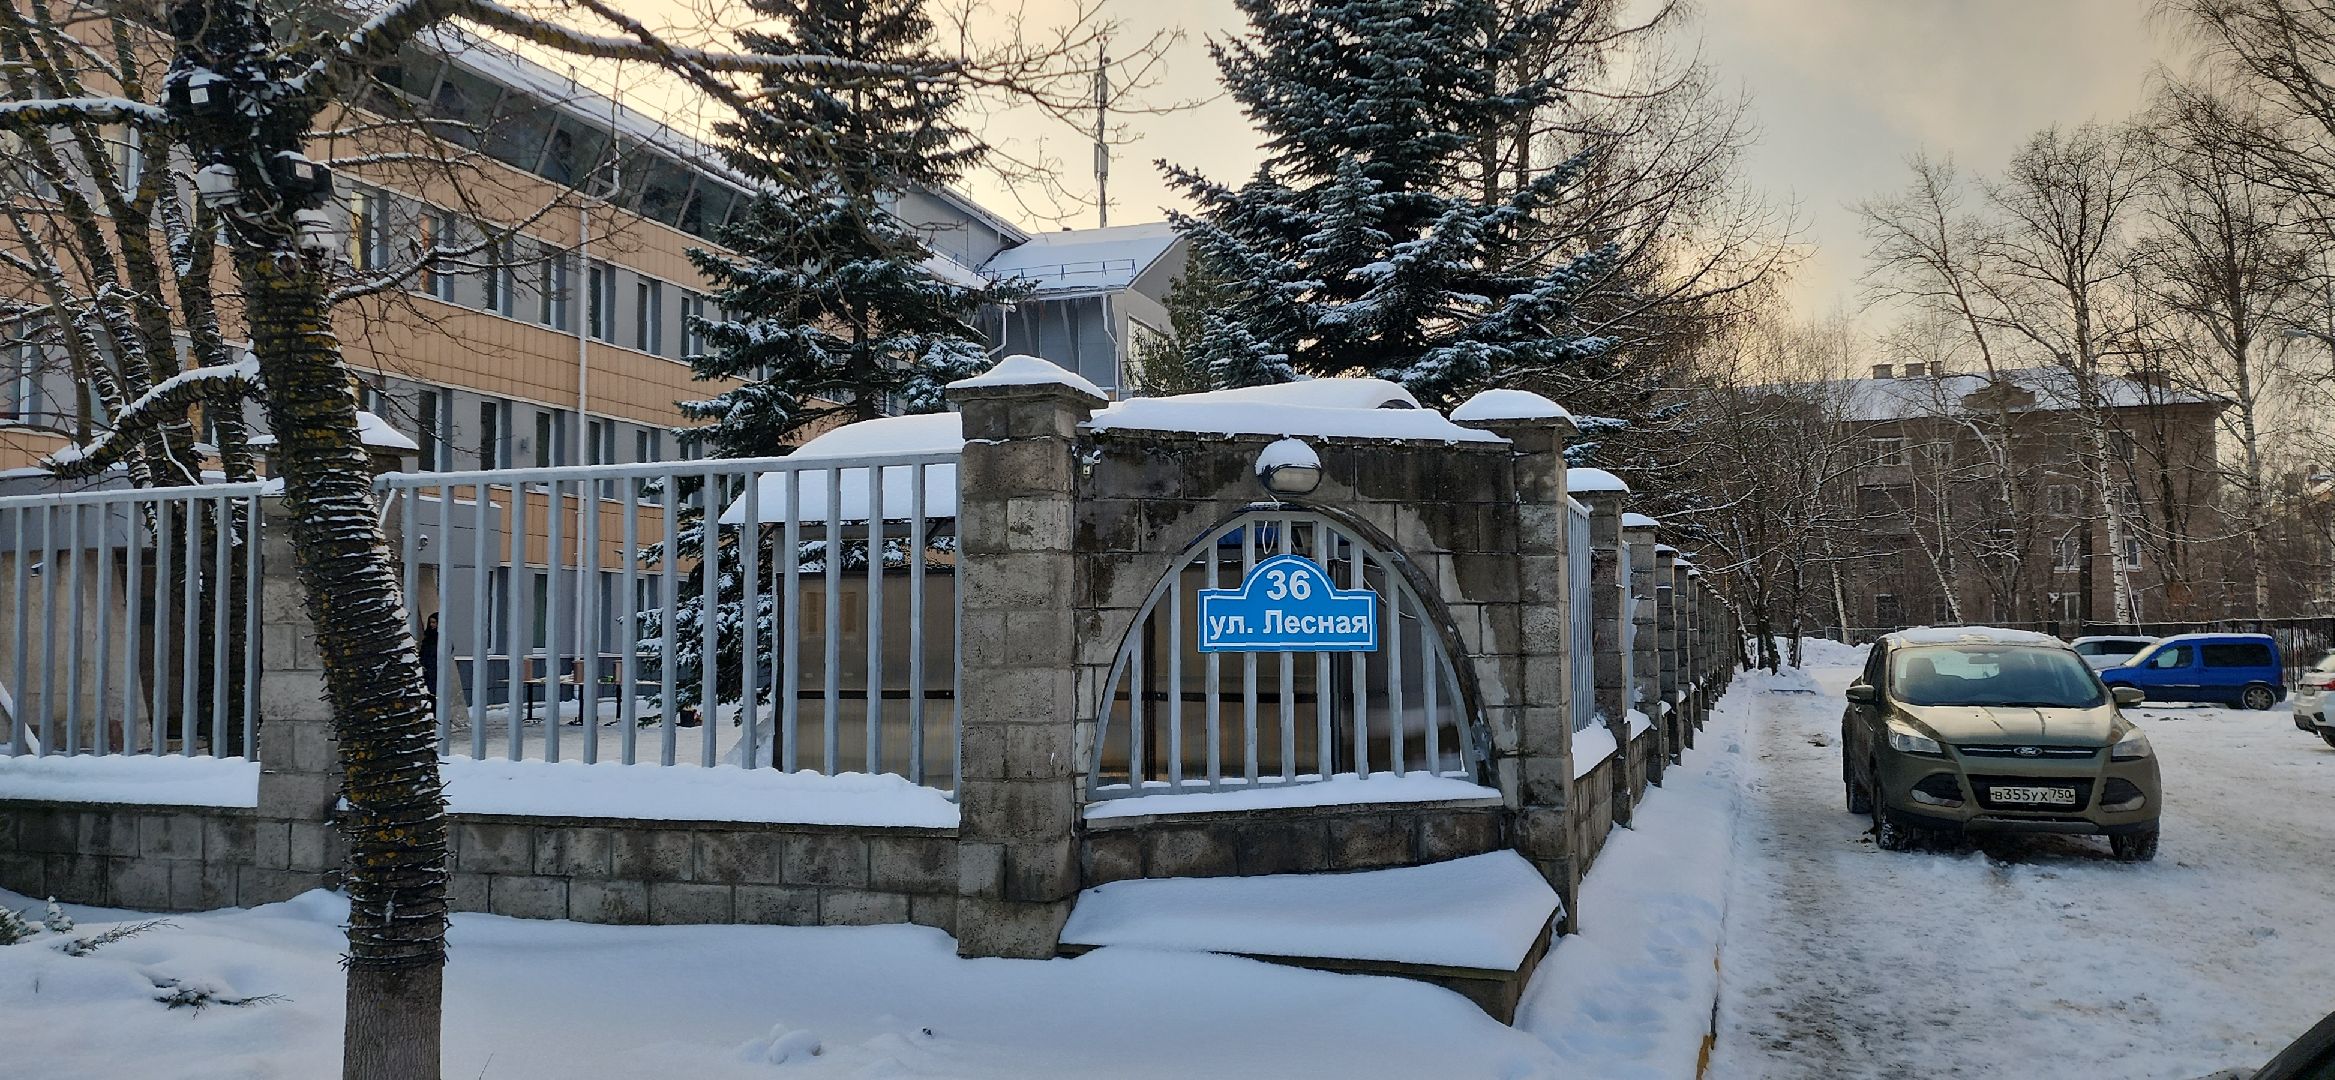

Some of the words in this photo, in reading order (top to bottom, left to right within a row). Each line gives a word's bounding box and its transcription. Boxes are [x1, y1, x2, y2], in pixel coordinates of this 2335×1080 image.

[1266, 569, 1312, 601] 36
[1209, 615, 1254, 640] ул.
[1262, 609, 1368, 634] Лесная
[2049, 788, 2072, 799] 750
